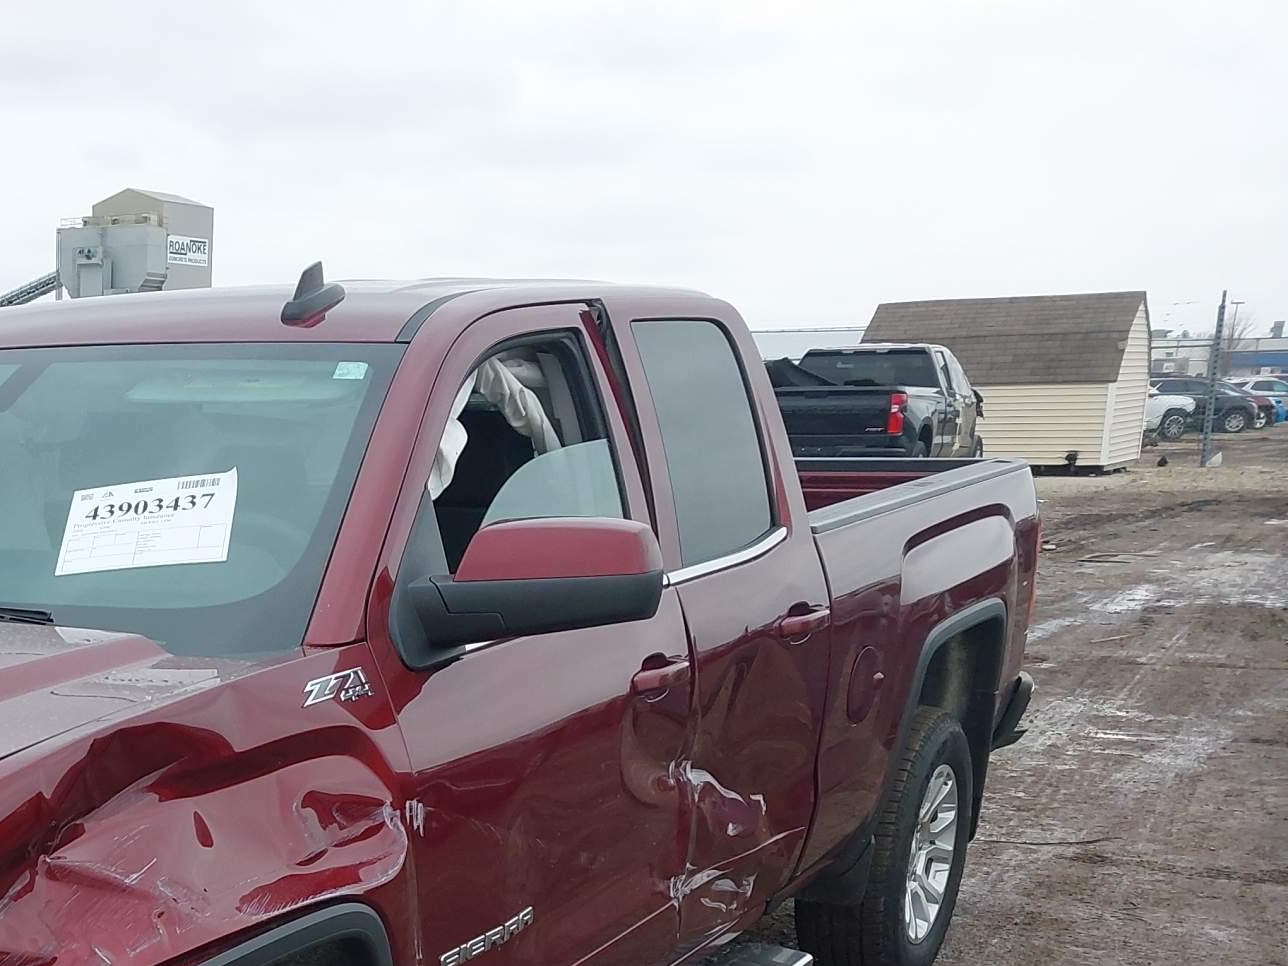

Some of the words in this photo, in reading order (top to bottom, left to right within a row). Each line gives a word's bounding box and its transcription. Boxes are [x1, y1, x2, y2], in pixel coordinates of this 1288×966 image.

[169, 240, 207, 255] ROANOKE
[85, 493, 215, 520] 43903437
[303, 666, 367, 707] Z71
